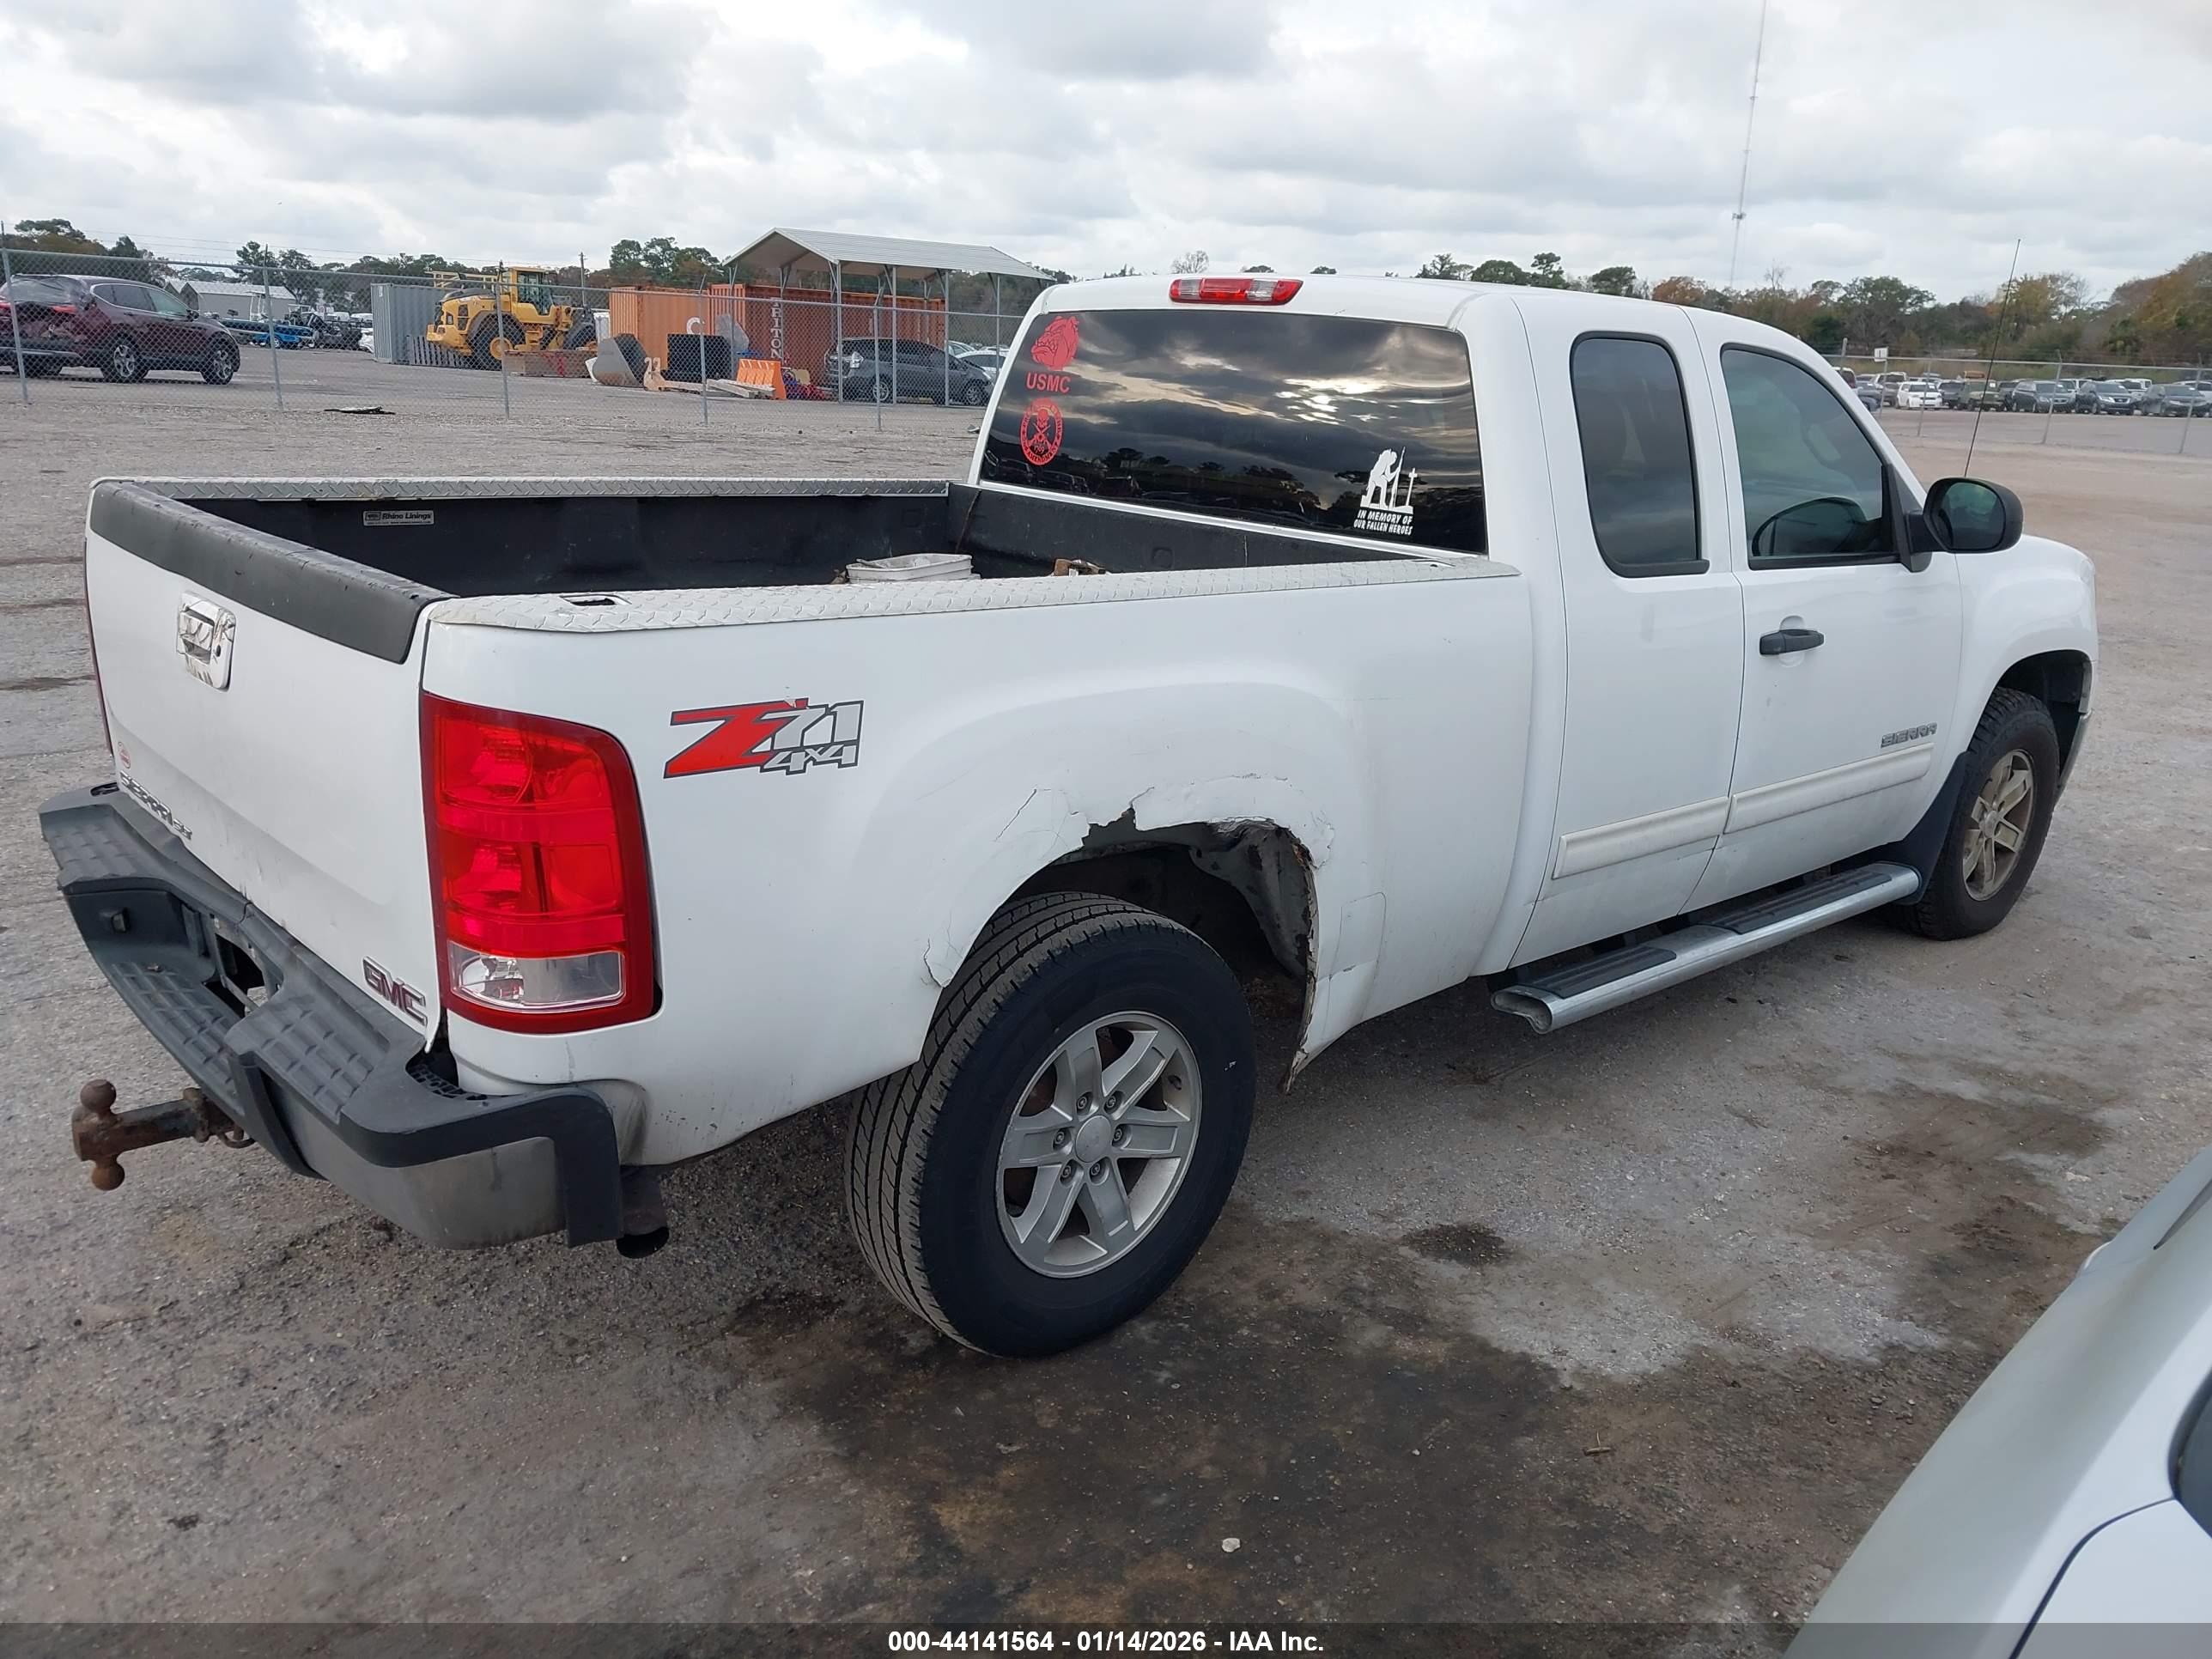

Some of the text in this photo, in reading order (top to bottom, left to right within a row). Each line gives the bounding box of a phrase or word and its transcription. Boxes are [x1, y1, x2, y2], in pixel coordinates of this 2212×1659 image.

[1026, 373, 1071, 392] USMC
[1353, 519, 1413, 535] OUR FALLEN HEROES
[1358, 509, 1413, 525] IN MEMORY OF
[664, 697, 864, 779] Z71
[1881, 722, 1937, 748] SIERRA
[119, 769, 173, 827] SIERRA
[362, 956, 428, 1027] GMC
